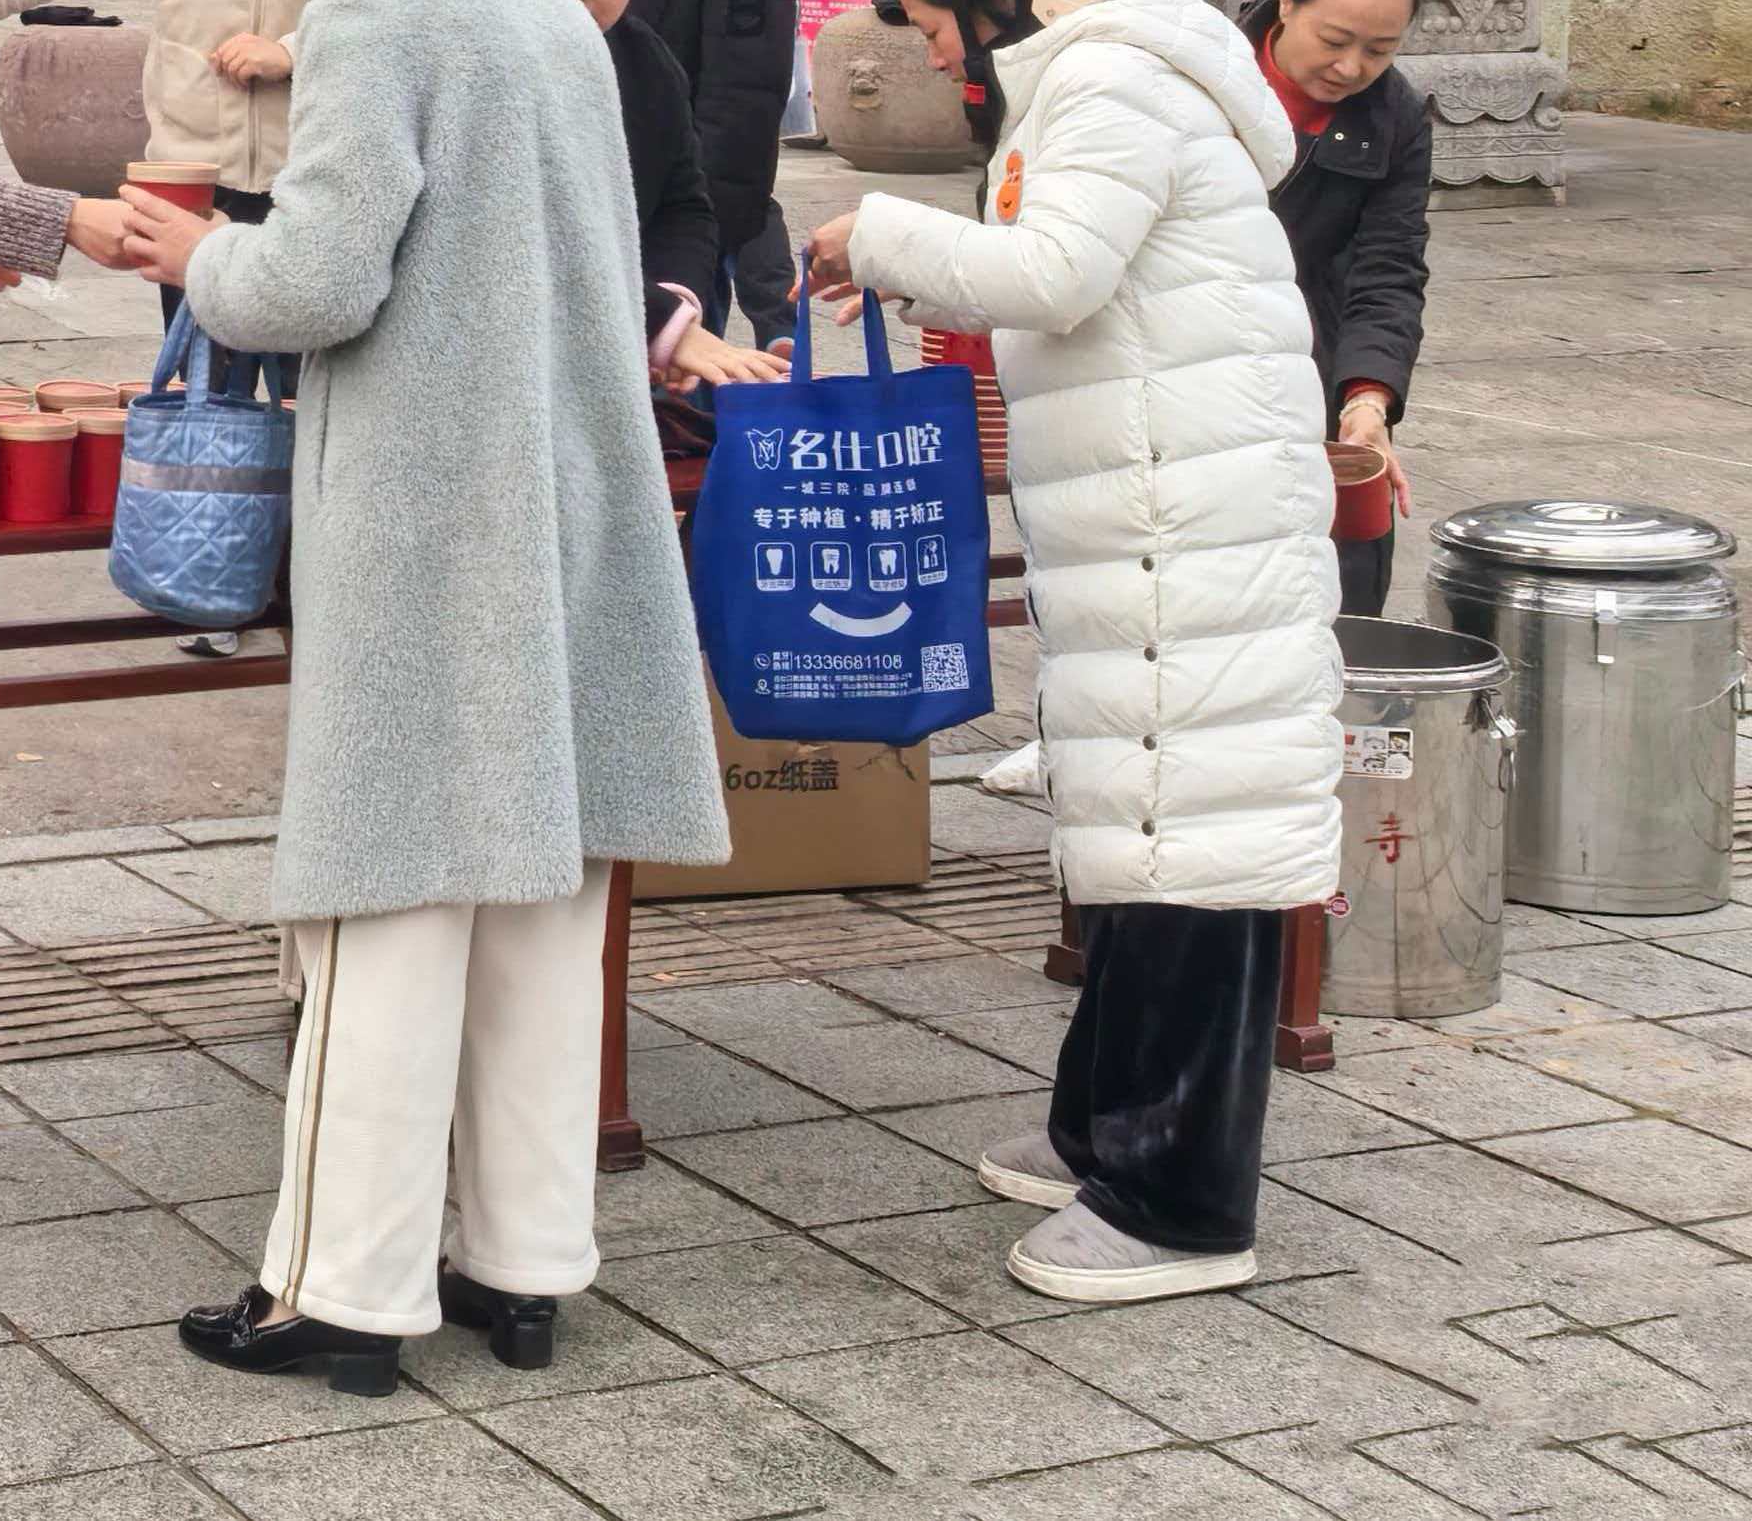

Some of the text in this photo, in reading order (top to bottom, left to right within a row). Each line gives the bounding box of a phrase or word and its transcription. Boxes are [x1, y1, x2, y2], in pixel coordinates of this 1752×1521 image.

[789, 422, 943, 472] 名仕口腔
[794, 654, 903, 670] 13336681108
